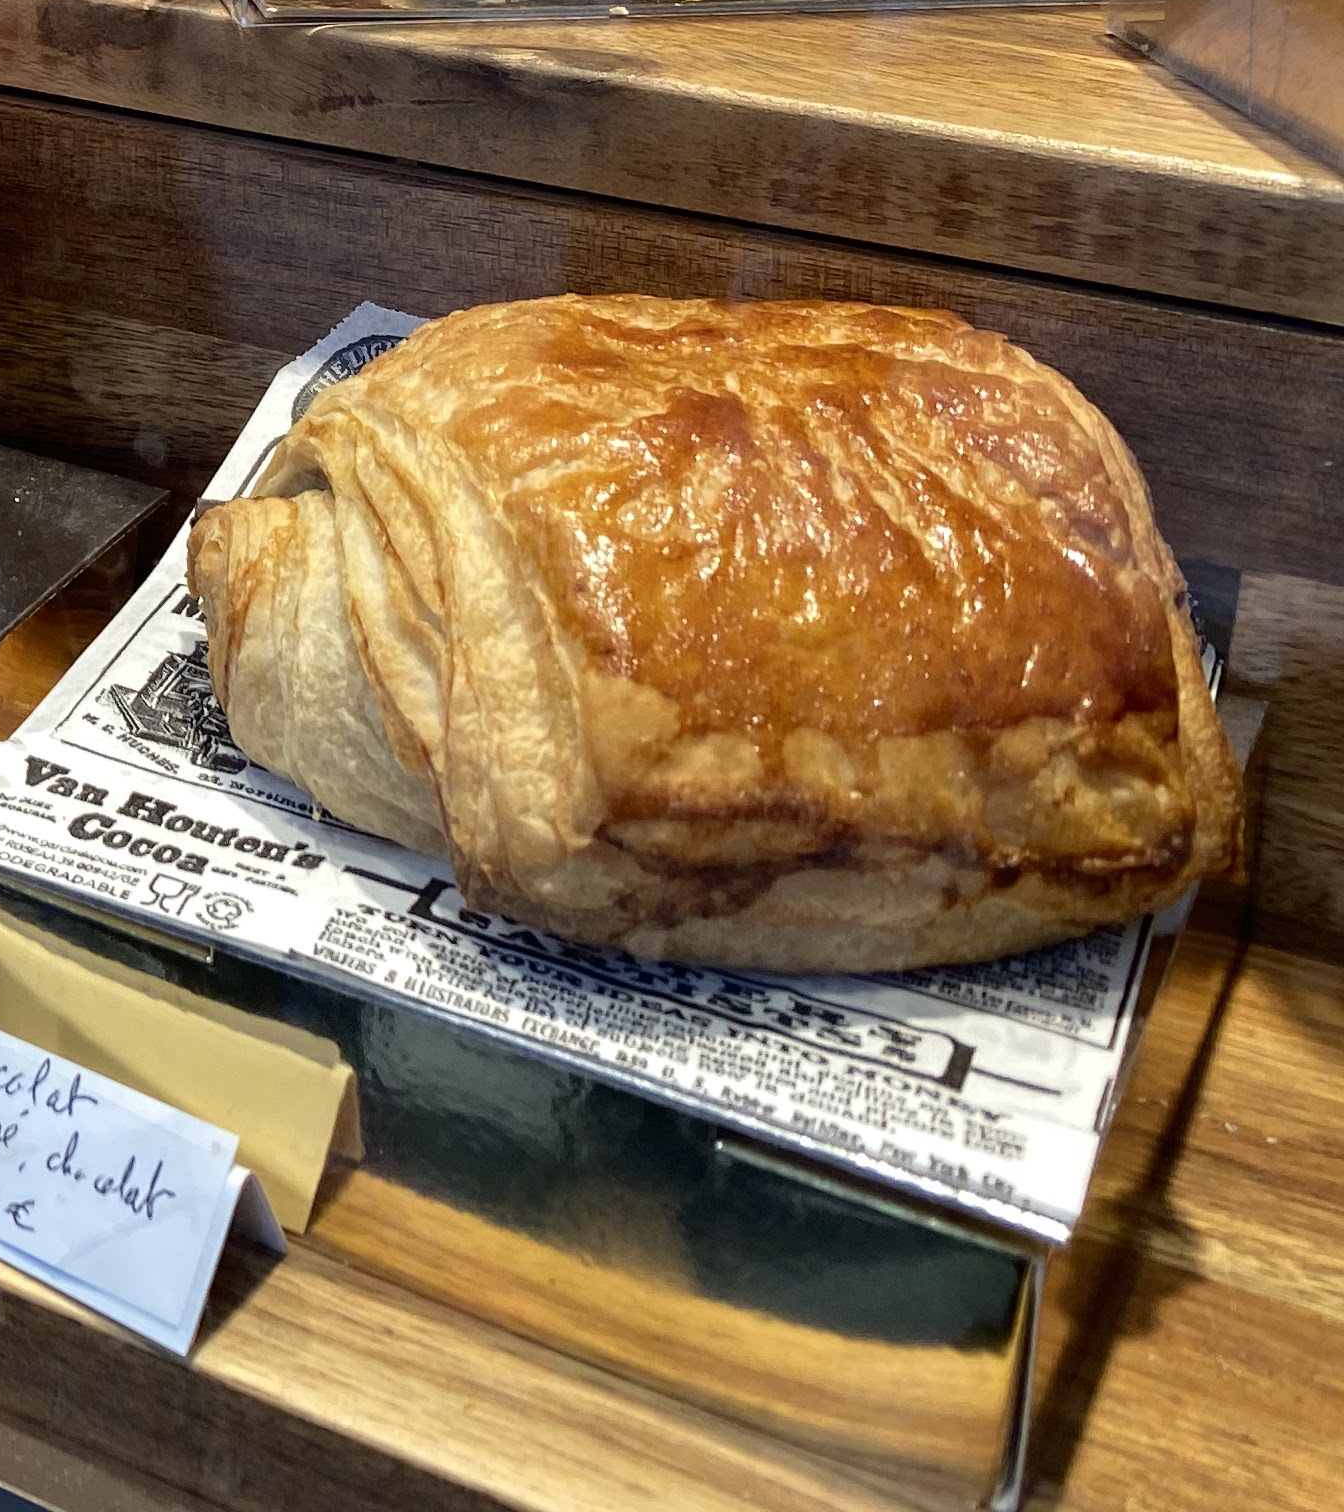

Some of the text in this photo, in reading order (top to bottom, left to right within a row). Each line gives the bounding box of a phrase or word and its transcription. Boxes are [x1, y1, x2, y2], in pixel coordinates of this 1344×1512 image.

[24, 754, 110, 807] Van
[116, 790, 326, 870] Houten's
[68, 812, 210, 876] Cocoa
[45, 1130, 179, 1222] chocolat
